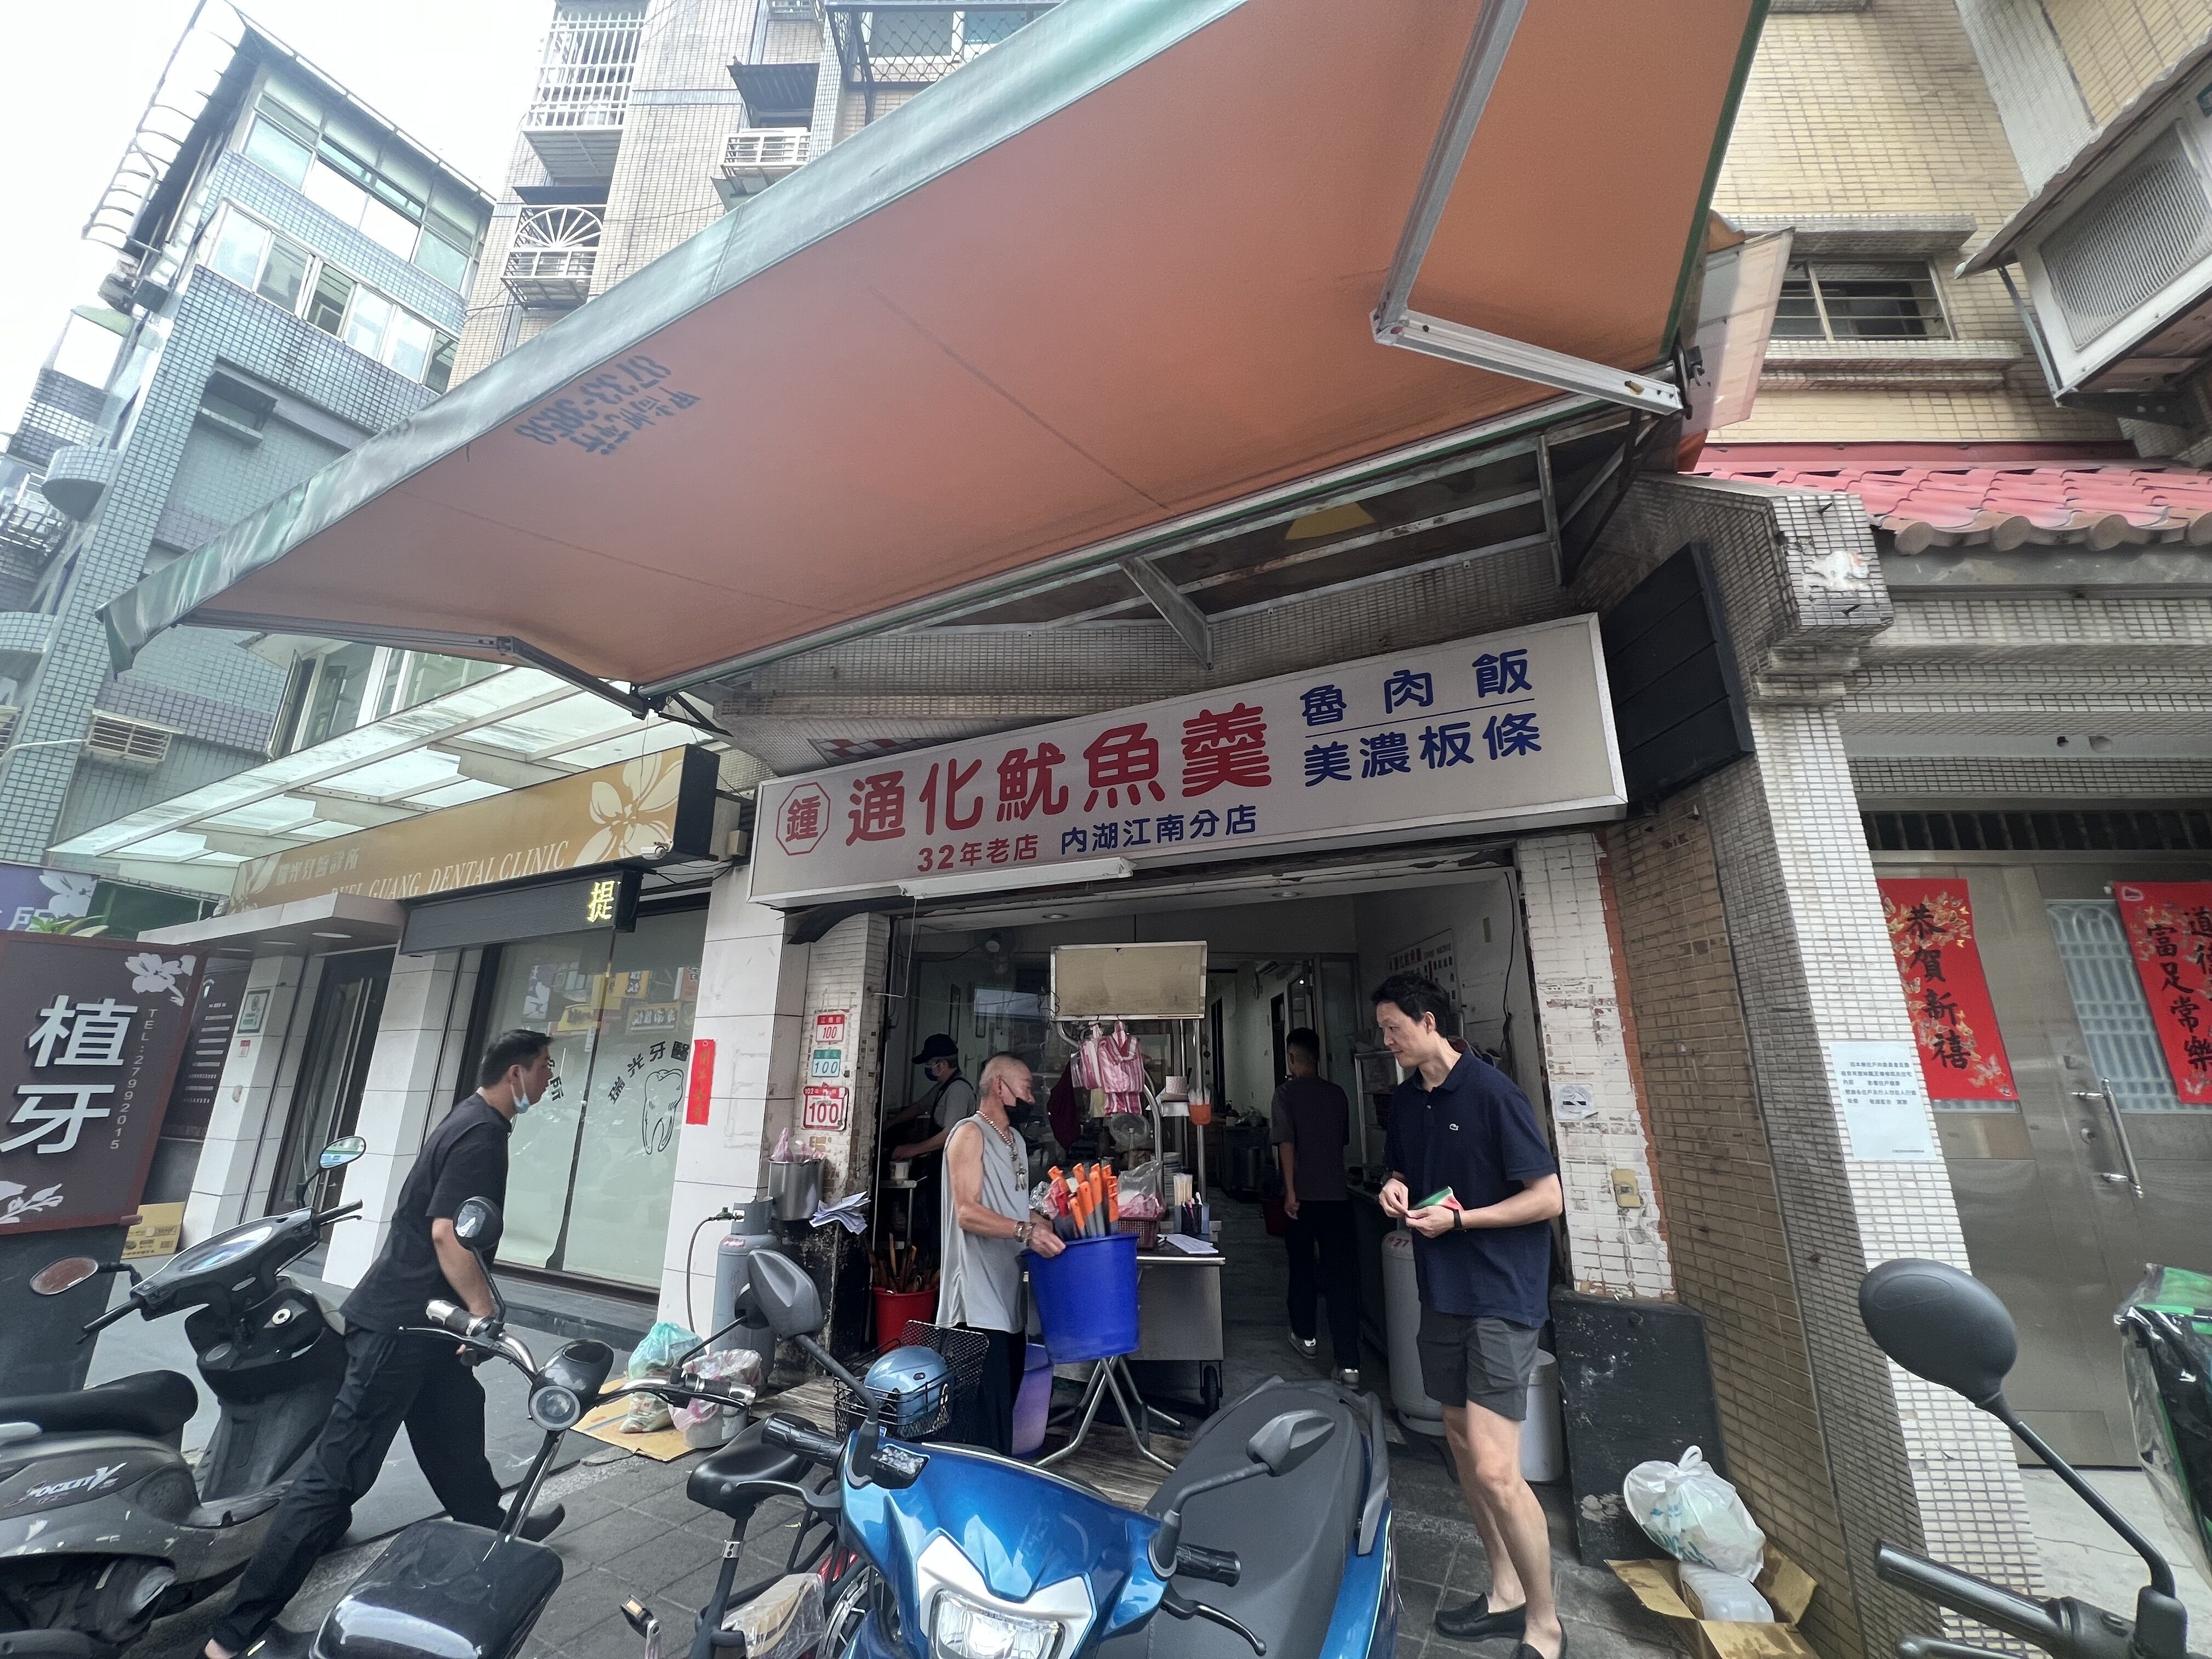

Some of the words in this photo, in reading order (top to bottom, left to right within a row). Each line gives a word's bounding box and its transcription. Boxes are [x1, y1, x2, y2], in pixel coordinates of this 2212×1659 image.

[1300, 648, 1533, 727] 魯肉飯
[845, 702, 1272, 847] 通化魷魚羹
[1304, 712, 1542, 787] 美濃板條
[368, 872, 422, 900] GUANG
[426, 857, 496, 894] DENTAL
[499, 840, 569, 880] CLINIC
[918, 833, 1038, 872] 32年老店
[587, 880, 616, 923] 提
[1905, 904, 1972, 1068] 恭賀新禧
[2147, 923, 2212, 1071] 富足常樂
[823, 1026, 837, 1039] 100
[0, 995, 138, 1154] 植牙
[815, 1062, 838, 1074] 100
[809, 1103, 839, 1124] 100
